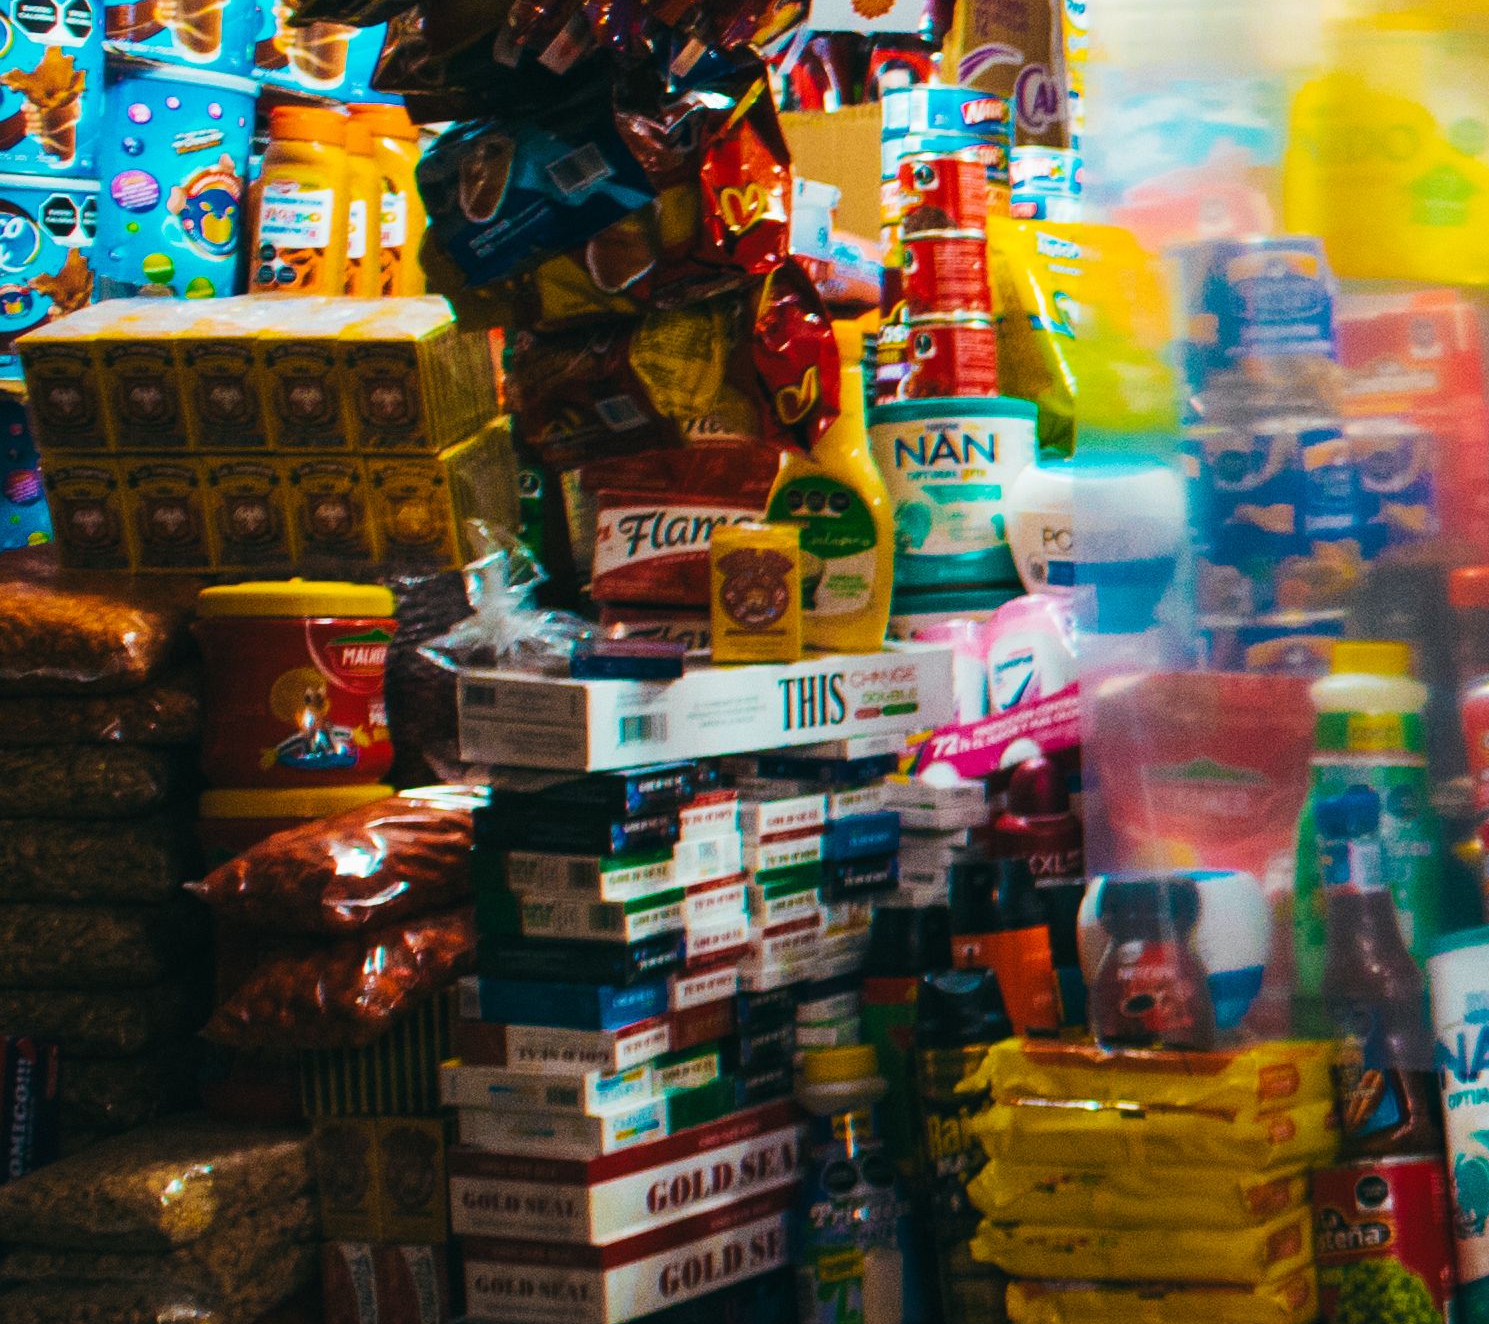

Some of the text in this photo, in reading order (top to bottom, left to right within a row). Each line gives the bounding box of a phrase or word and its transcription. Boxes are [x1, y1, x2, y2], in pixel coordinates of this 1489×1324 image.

[894, 429, 996, 468] NAN
[778, 673, 847, 732] THIS
[646, 1137, 796, 1215] GOLD SEA
[462, 1191, 579, 1219] GOLD SEAL
[659, 1227, 782, 1300] GOLD SE
[474, 1276, 591, 1303] GOLD SEAL
